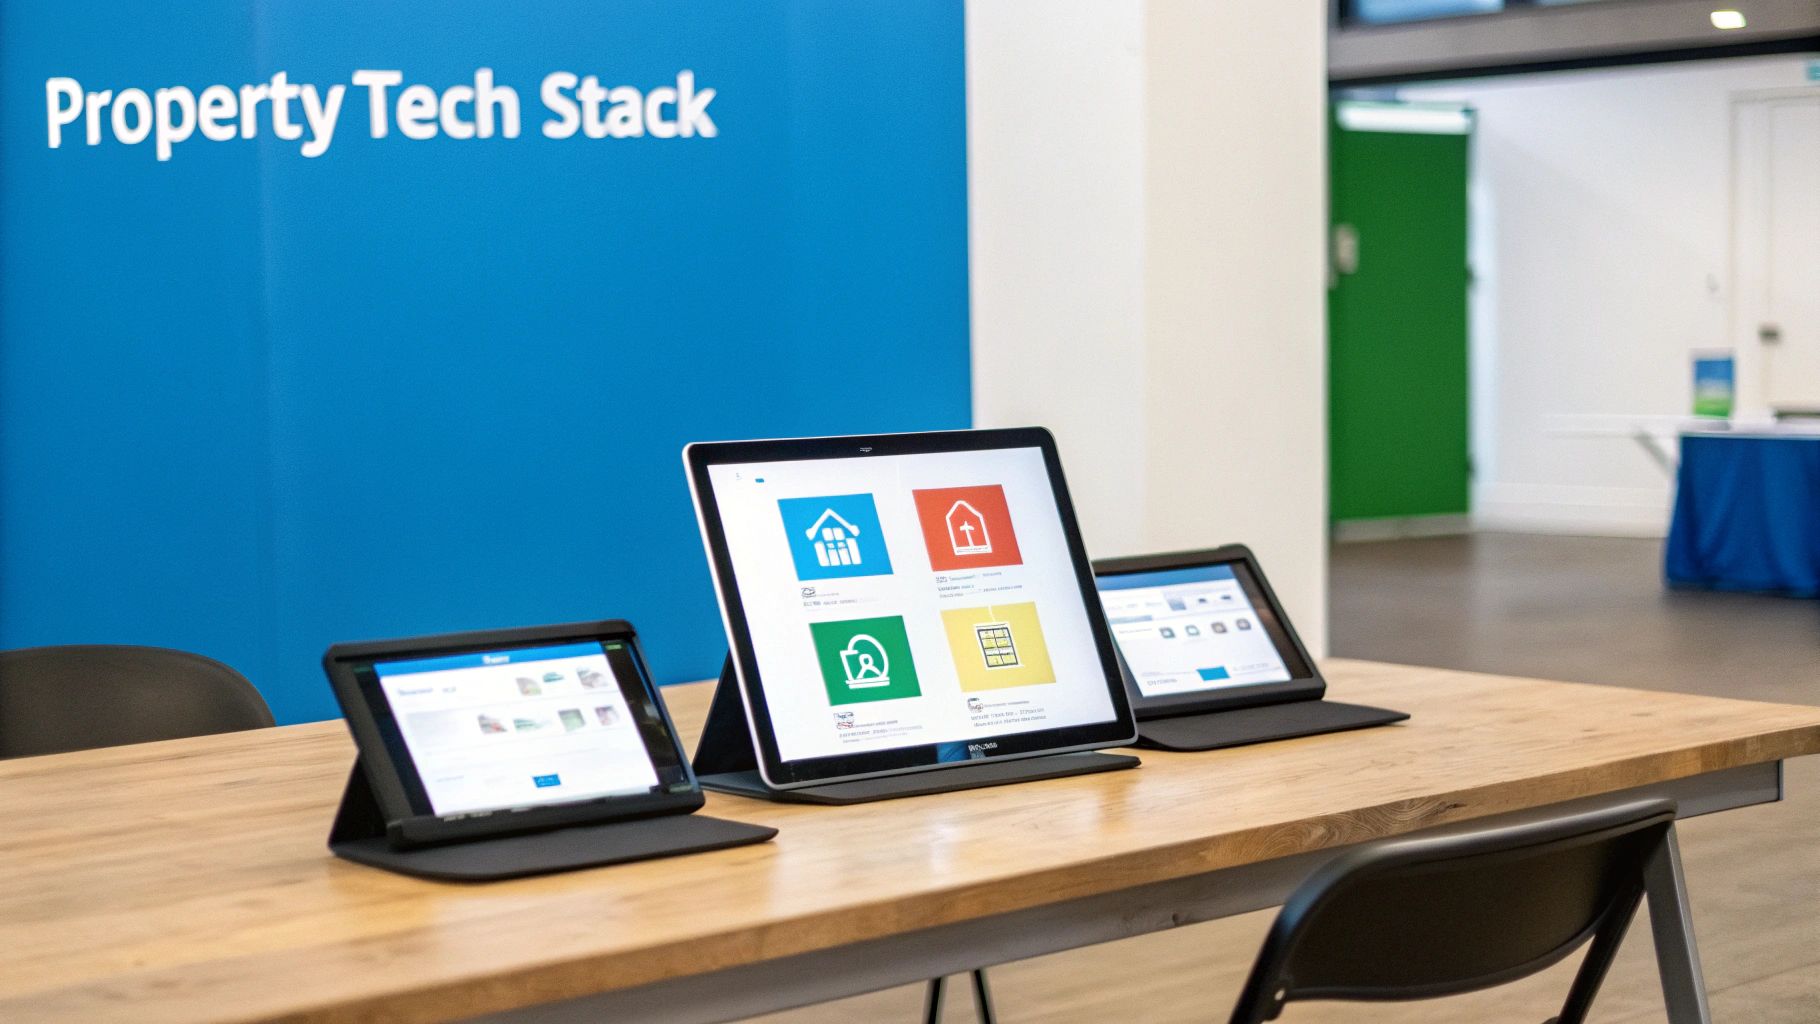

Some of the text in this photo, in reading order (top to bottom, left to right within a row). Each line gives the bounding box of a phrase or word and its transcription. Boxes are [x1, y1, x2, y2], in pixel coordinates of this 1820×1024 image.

[45, 67, 718, 161] Property Tech Stack
